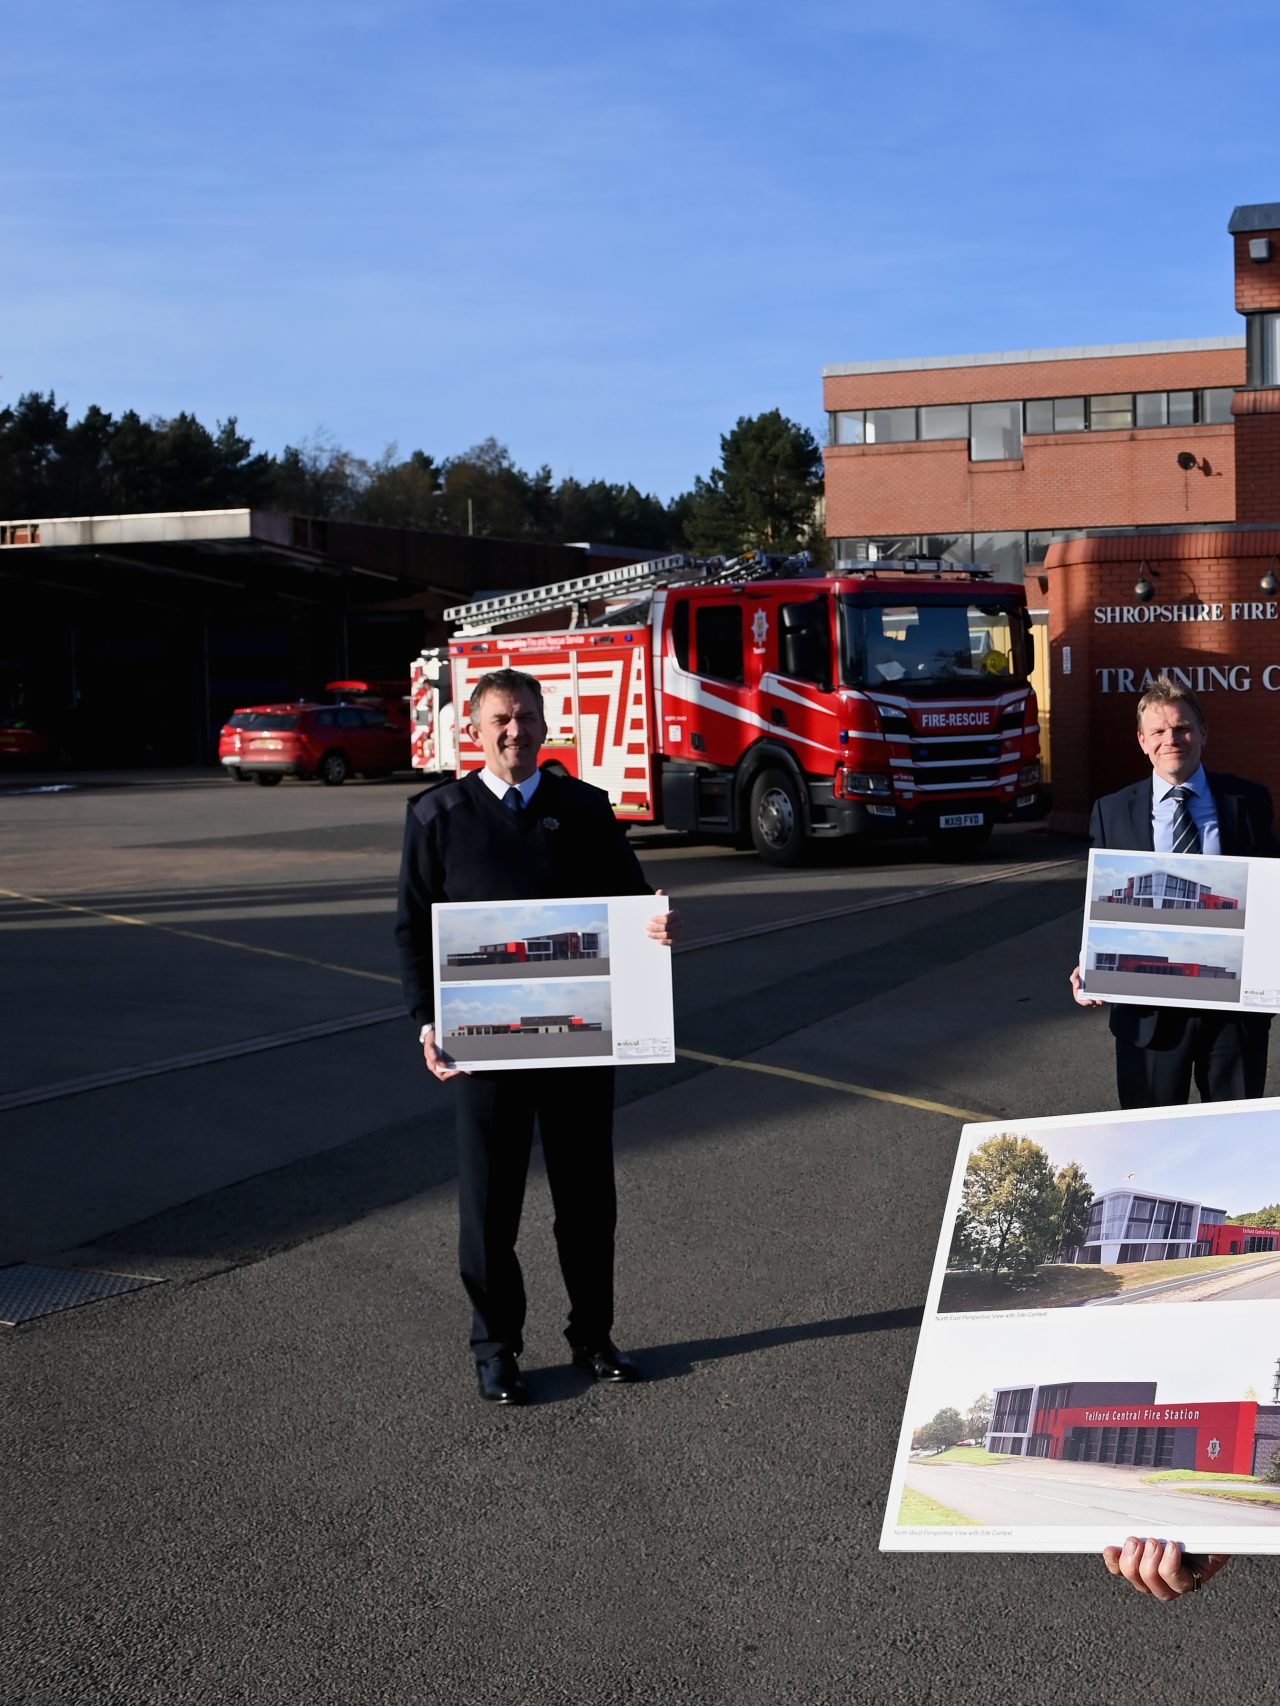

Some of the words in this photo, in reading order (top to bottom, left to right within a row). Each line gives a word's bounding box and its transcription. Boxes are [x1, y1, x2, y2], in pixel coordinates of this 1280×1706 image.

[1094, 603, 1225, 624] SHROPSHIRE
[1230, 601, 1279, 621] FIRE
[922, 712, 990, 728] FIRE-RESCUE
[1085, 1411, 1110, 1421] Telford
[1112, 1409, 1141, 1421] Central
[1144, 1409, 1161, 1420] Fire
[1164, 1408, 1200, 1420] Station
